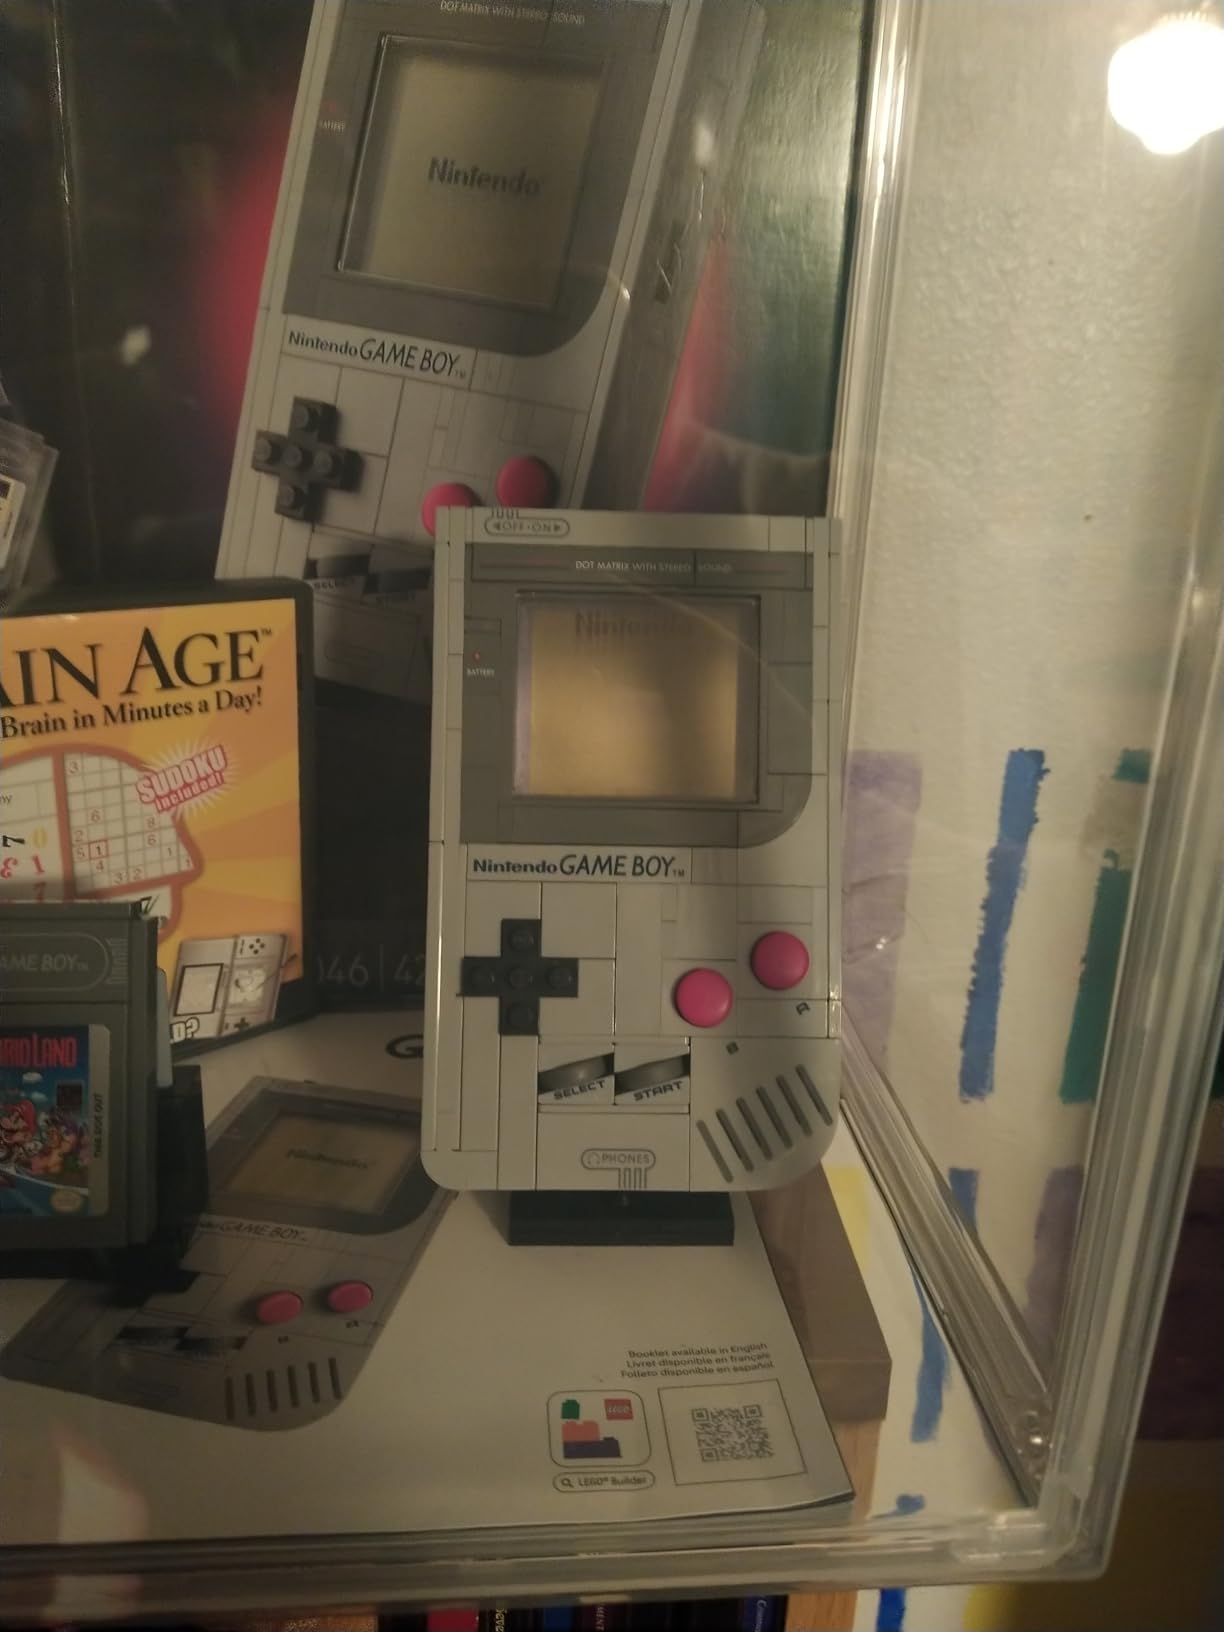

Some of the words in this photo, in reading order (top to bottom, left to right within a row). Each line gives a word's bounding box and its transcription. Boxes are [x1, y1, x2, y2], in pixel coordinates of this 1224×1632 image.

[288, 329, 359, 357] Nintendo
[359, 338, 419, 370] GAME
[575, 560, 595, 570] DOT
[597, 560, 631, 571] MATRIX
[632, 561, 657, 572] WITH
[1, 712, 67, 738] Brain
[73, 709, 96, 730] in
[102, 700, 193, 727] Minutes
[198, 699, 209, 714] a
[215, 684, 263, 714] Day!
[136, 743, 229, 805] SUDOKU
[472, 857, 558, 874] Nintendo
[559, 853, 628, 877] GAME
[553, 1079, 607, 1100] SELECT
[632, 1080, 684, 1102] START
[601, 1152, 651, 1165] PHONES
[625, 1359, 657, 1369] Livret
[658, 1355, 713, 1369] disponible
[714, 1357, 728, 1365] en
[627, 1350, 669, 1360] Booklet
[671, 1346, 718, 1357] available
[719, 1345, 730, 1354] in
[660, 1365, 715, 1378] disponible
[716, 1366, 731, 1375] en
